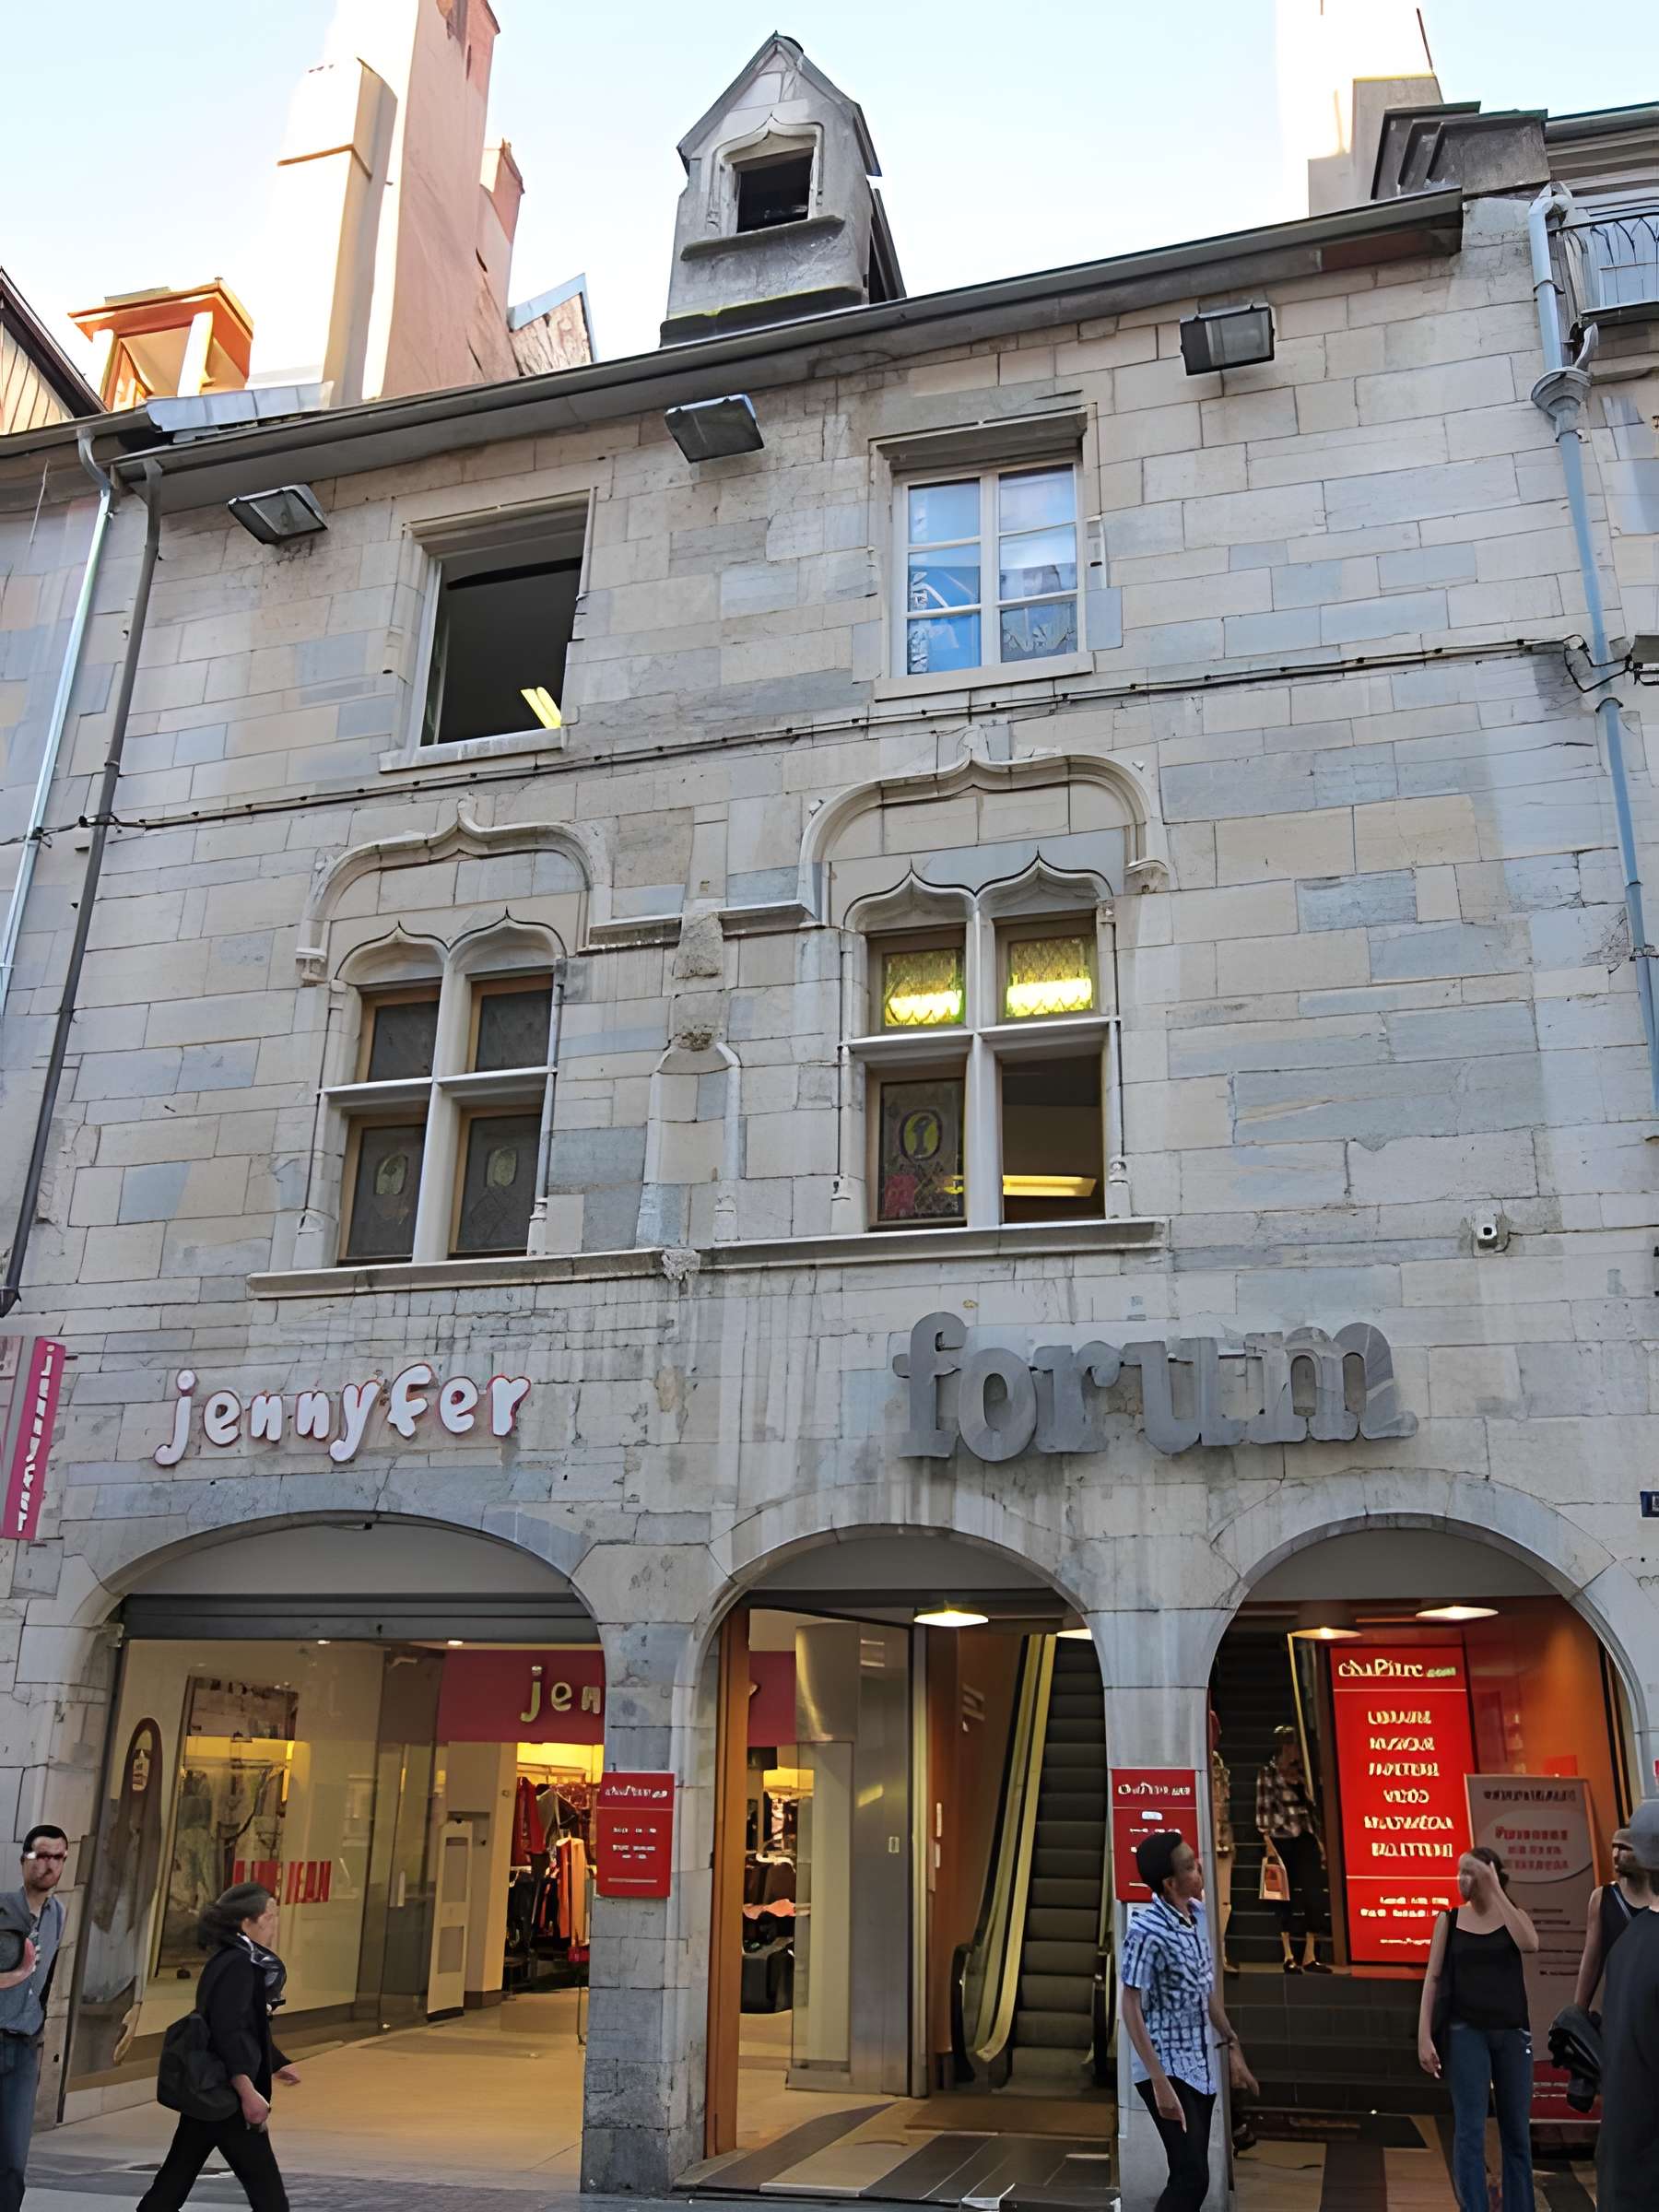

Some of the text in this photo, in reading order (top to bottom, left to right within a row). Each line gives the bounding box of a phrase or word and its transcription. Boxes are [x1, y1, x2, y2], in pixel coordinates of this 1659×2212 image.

[153, 1363, 532, 1467] jennyfer
[892, 1311, 1418, 1462] forum
[520, 1665, 601, 1723] jen
